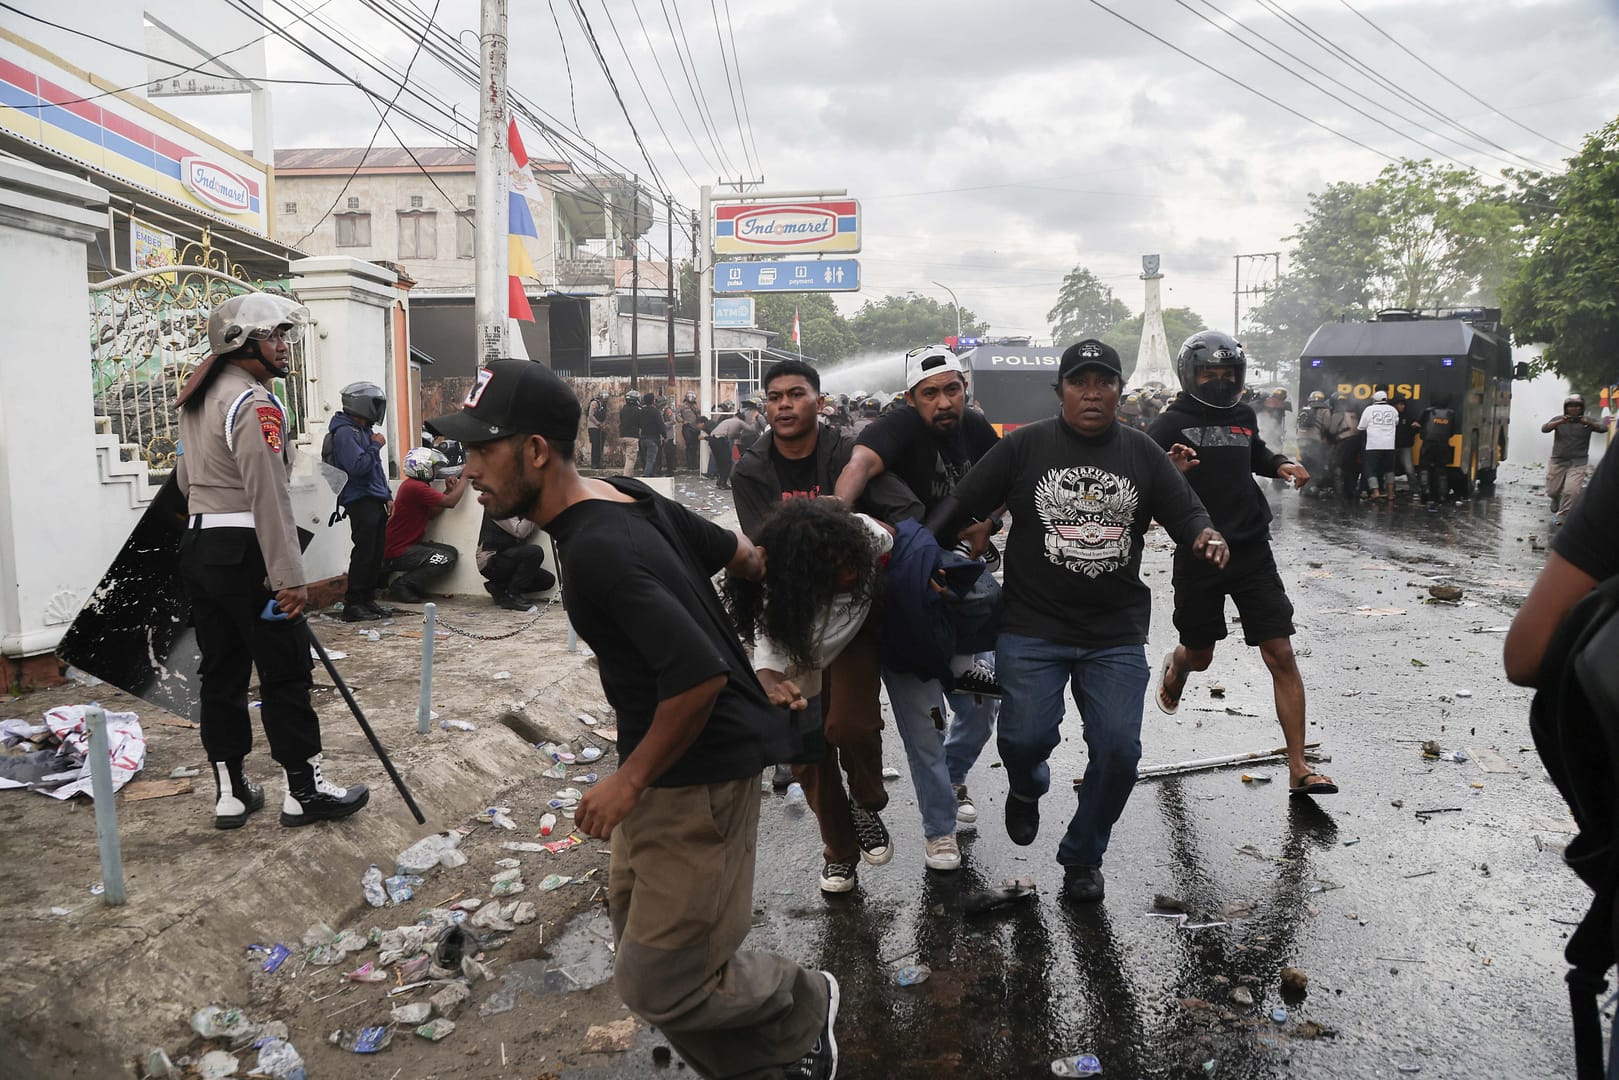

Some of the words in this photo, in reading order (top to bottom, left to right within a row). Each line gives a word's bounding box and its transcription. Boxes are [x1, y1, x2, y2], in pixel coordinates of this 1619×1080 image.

[194, 168, 245, 203] Indomaret
[741, 217, 828, 235] Indomaret
[136, 231, 162, 248] EMBER
[717, 308, 738, 317] ATM
[992, 356, 1062, 365] POLISI
[1372, 410, 1394, 425] 22
[1063, 467, 1116, 489] JAYAPURA
[1076, 481, 1104, 500] 16
[1077, 513, 1105, 524] HTCI
